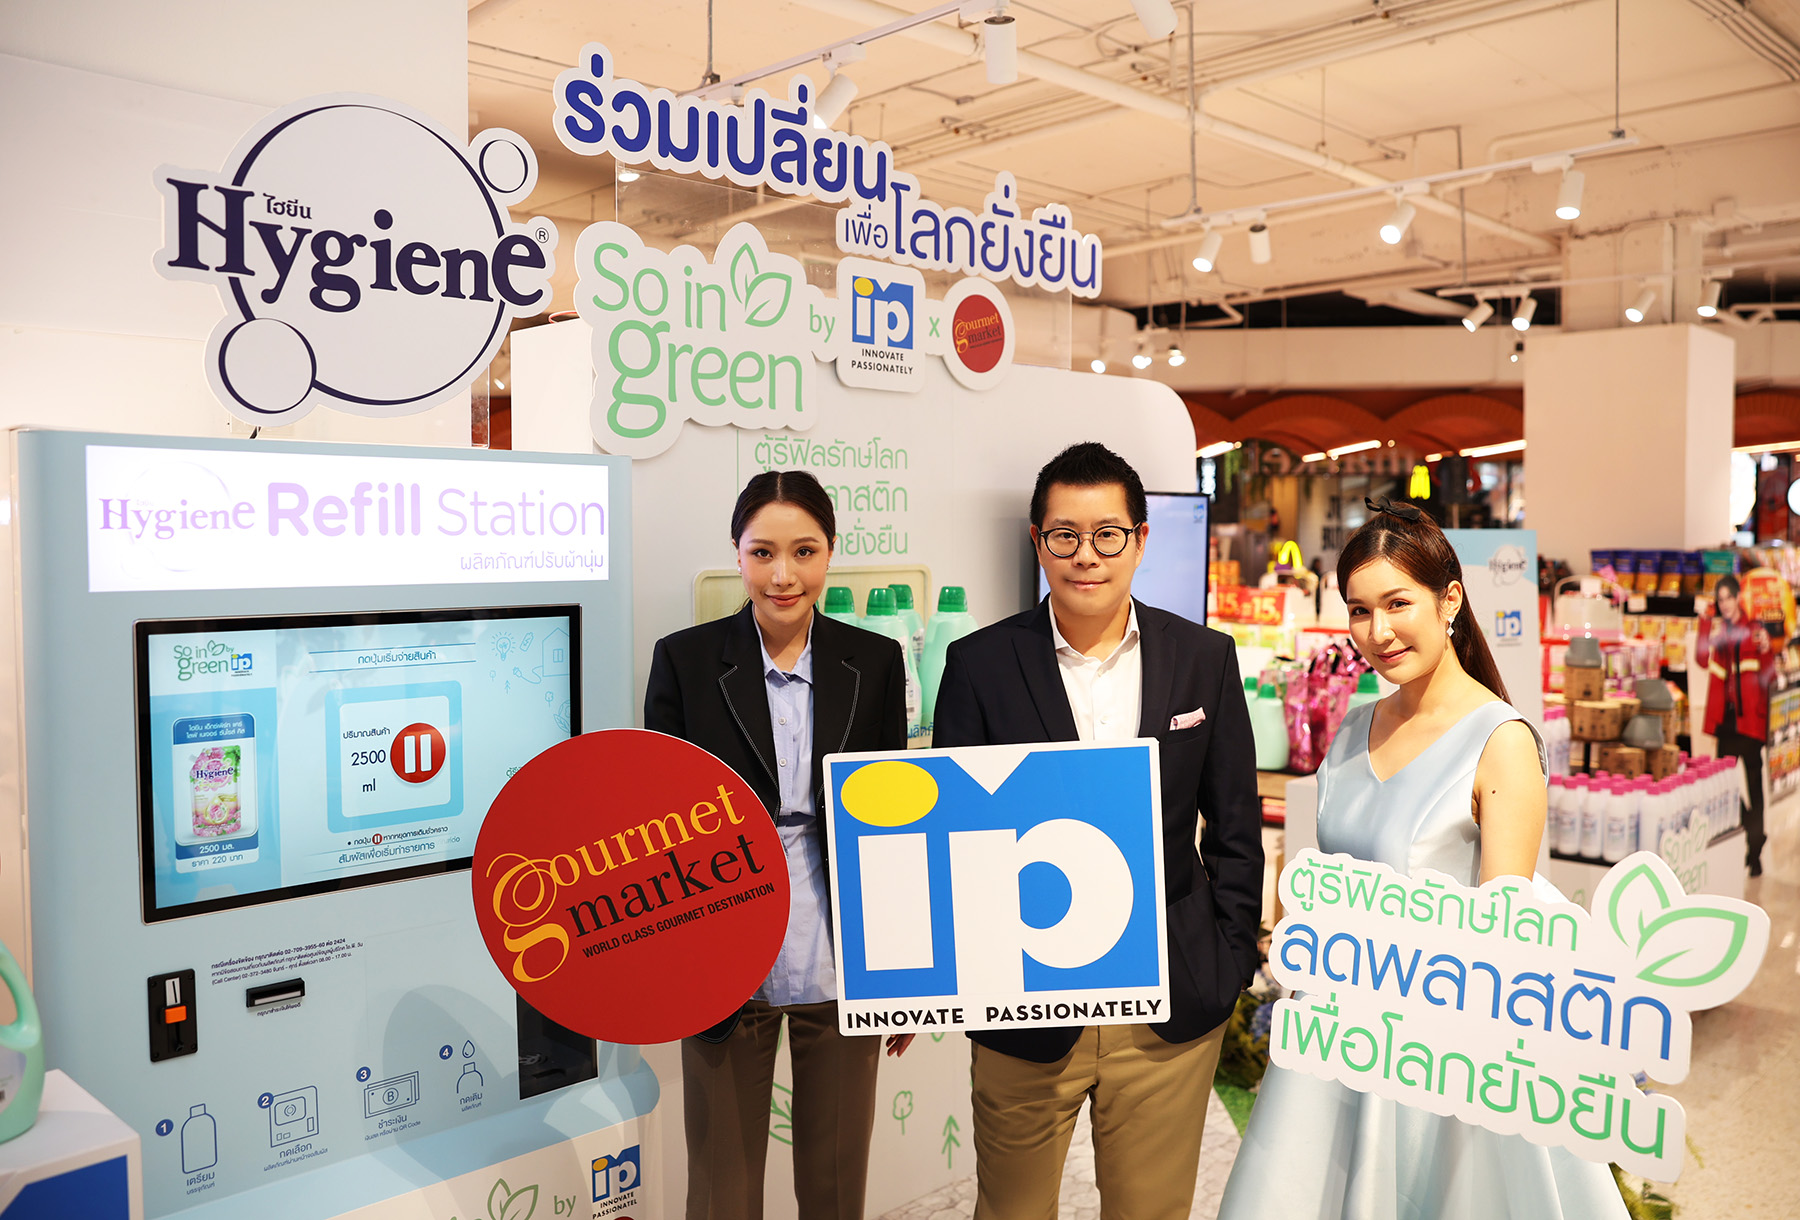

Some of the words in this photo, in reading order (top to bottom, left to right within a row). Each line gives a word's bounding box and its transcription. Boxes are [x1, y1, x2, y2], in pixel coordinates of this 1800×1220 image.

[564, 53, 887, 202] ร่วมเปลี่ยน
[263, 193, 312, 220] ไฮยีน
[166, 177, 546, 313] Hygiene
[844, 183, 1097, 290] เพื่อโลกยั่งยืน
[592, 242, 669, 317] So
[684, 266, 727, 332] in
[852, 275, 914, 350] ip
[954, 312, 1000, 354] gourmet
[967, 325, 1002, 345] market
[851, 360, 913, 375] PASSIONATELY
[861, 348, 904, 361] INNOVATE
[606, 319, 804, 440] green
[809, 303, 835, 343] by
[754, 434, 908, 473] ตู้รีฟิลรักษ์โลก
[824, 481, 908, 512] ลาสติก
[99, 498, 255, 539] Hygiene
[268, 482, 421, 538] Refill
[437, 488, 606, 536] Station
[836, 518, 908, 556] กยั่งยืน
[460, 551, 604, 572] ผลิตภัณฑ์ปรับผ้านุ่ม
[173, 645, 192, 659] So
[195, 646, 207, 658] in
[357, 650, 437, 666] กดปุ่มเริ่มจ่ายสินค้า
[177, 657, 229, 681] green
[342, 727, 391, 740] ปริมาณสินค้า
[351, 749, 386, 766] 2500
[196, 766, 234, 780] Hygiene
[362, 778, 376, 793] ml
[192, 859, 209, 868] ราคา
[212, 855, 227, 864] 220
[230, 853, 244, 862] บาท
[199, 844, 219, 854] 2500
[486, 784, 745, 983] gourmet
[565, 834, 765, 938] market
[836, 753, 1148, 997] ip
[1290, 858, 1578, 951] ตู้รีฟิลรักษ์โลก
[583, 937, 621, 958] WORLD
[621, 924, 656, 945] CLASS
[656, 907, 706, 933] GOURMET
[707, 882, 775, 915] DESTINATION
[1280, 923, 1671, 1061] ลดพลาสติก
[847, 1008, 965, 1029] INNOVATE
[986, 999, 1162, 1022] PASSIONATELY
[442, 1048, 450, 1057] 4
[360, 1069, 367, 1080] 3
[1281, 992, 1666, 1159] เพื่อโลกยั่งยืน
[260, 1094, 271, 1107] 2
[378, 1114, 408, 1129] ชำระเงิน
[279, 1142, 312, 1159] กดเลือก
[186, 1171, 215, 1187] เตรียม
[591, 1144, 641, 1203] ip
[553, 1195, 577, 1217] by
[600, 1191, 634, 1209] INNOVATE
[592, 1198, 638, 1220] PASSIONATEL
